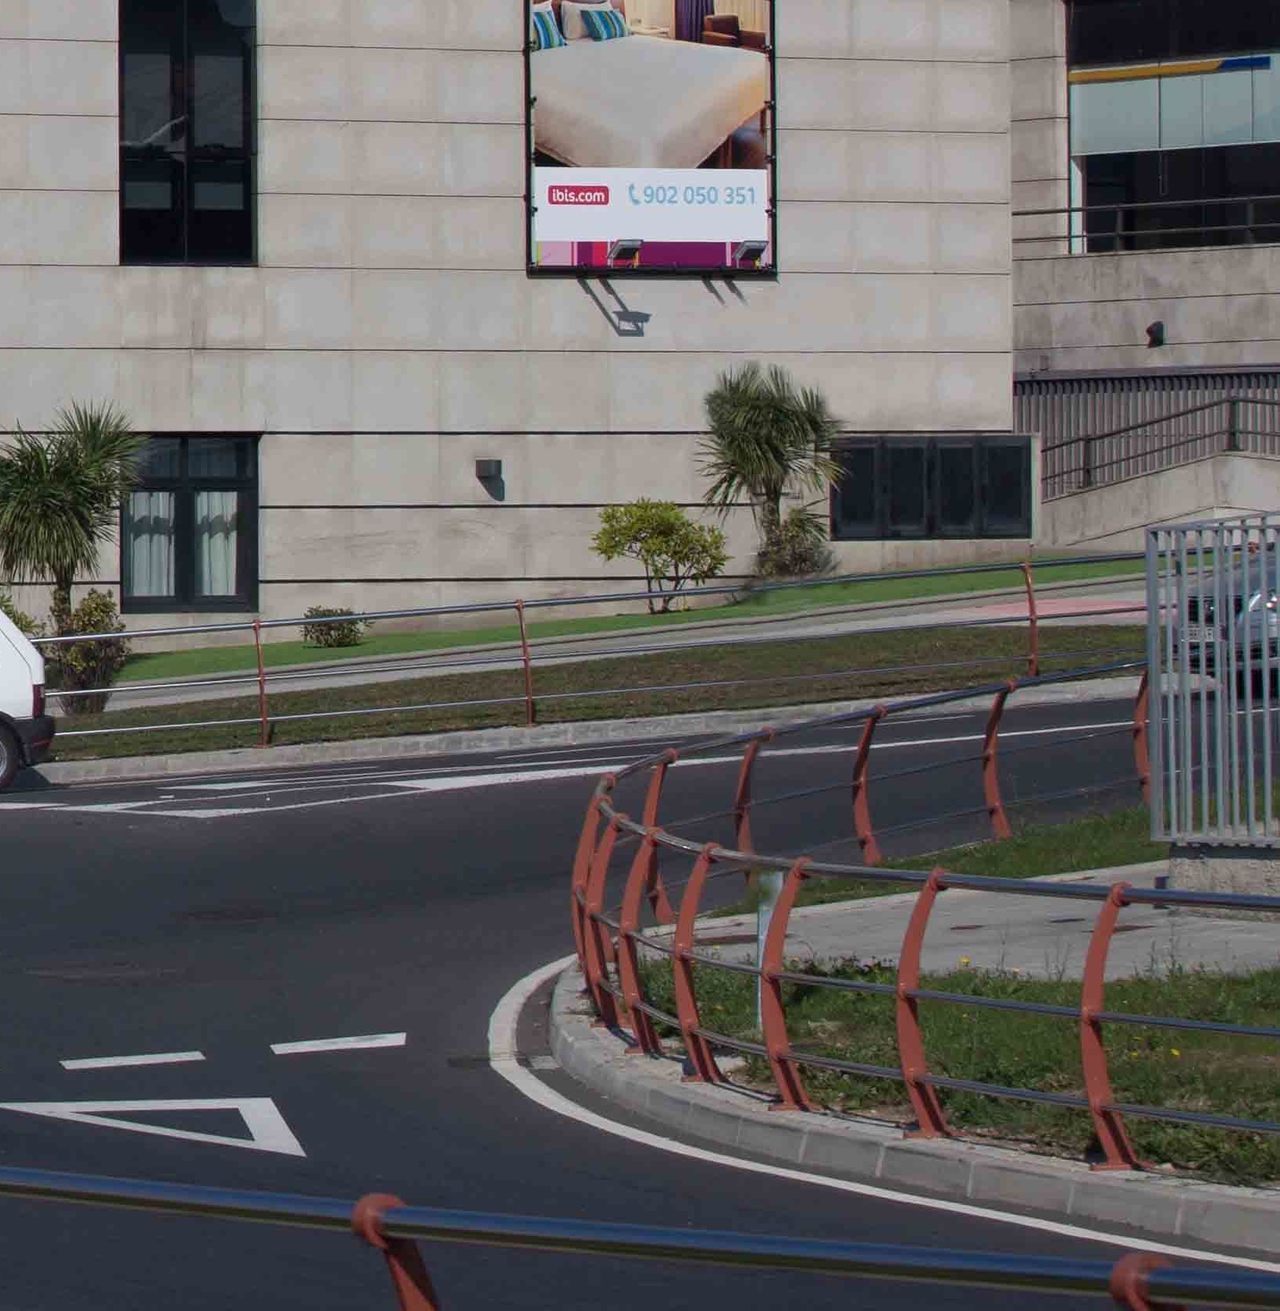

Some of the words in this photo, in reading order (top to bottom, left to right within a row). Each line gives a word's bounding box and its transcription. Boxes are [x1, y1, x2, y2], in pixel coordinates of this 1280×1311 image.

[552, 188, 605, 204] ibis.com
[643, 186, 678, 204] 902
[683, 186, 719, 205] 050
[725, 187, 756, 205] 351
